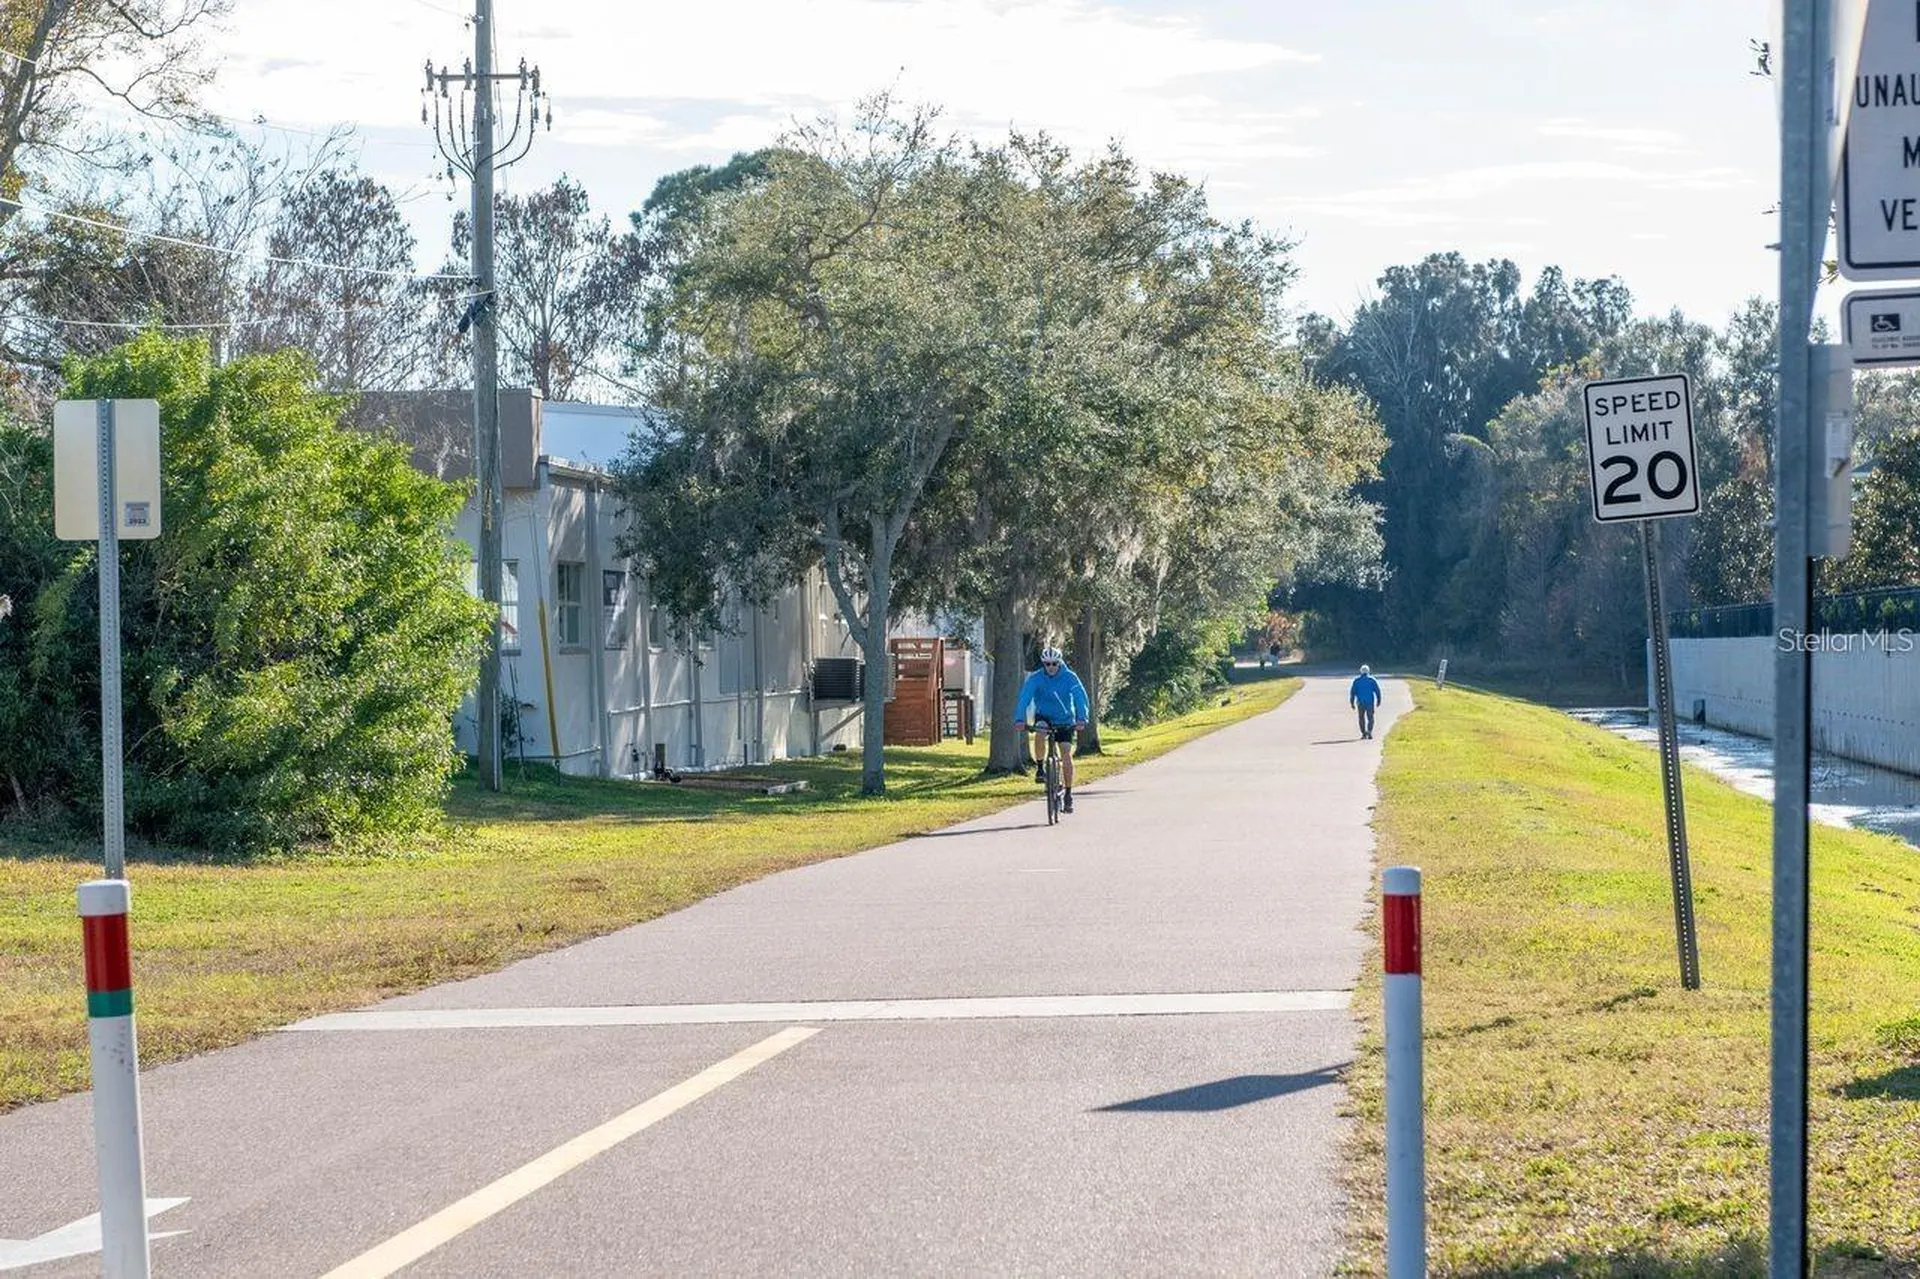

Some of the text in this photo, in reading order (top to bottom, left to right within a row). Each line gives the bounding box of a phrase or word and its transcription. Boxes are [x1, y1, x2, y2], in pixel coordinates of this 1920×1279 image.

[1880, 198, 1918, 232] VE
[1594, 390, 1681, 416] SPEED
[1606, 421, 1673, 446] LIMIT
[1599, 450, 1688, 506] 20
